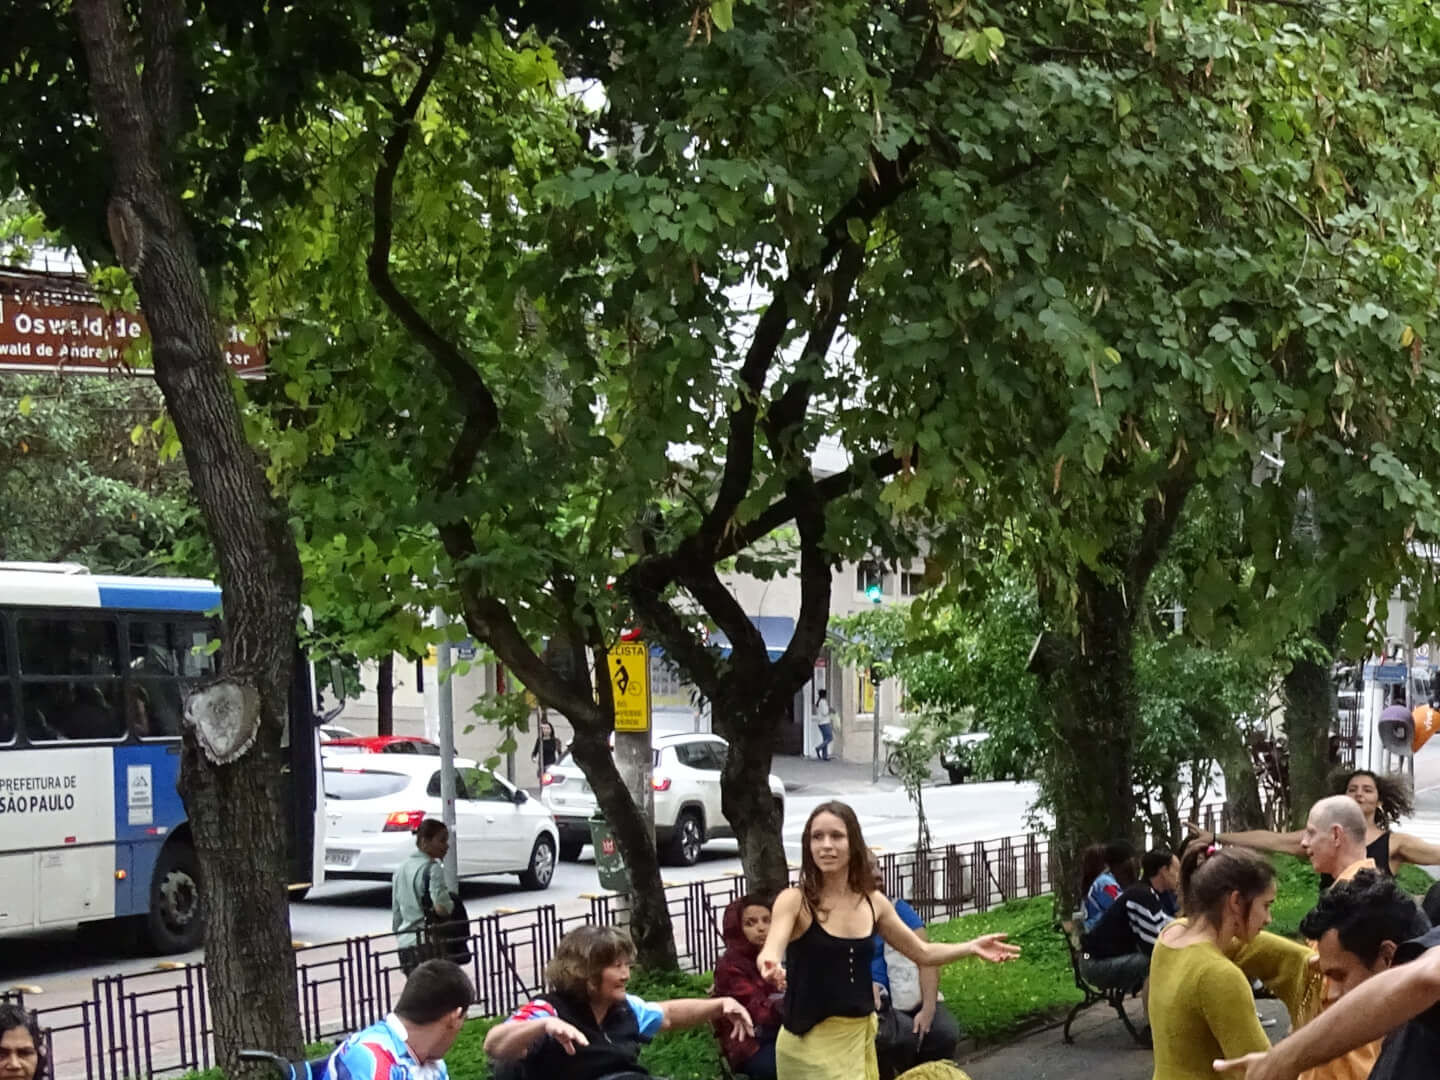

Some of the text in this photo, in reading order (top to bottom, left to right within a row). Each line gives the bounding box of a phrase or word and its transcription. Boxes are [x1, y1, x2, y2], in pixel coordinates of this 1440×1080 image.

[36, 344, 54, 357] de
[0, 776, 77, 791] PREFEITURA DE
[0, 792, 75, 813] SÃO PAULO
